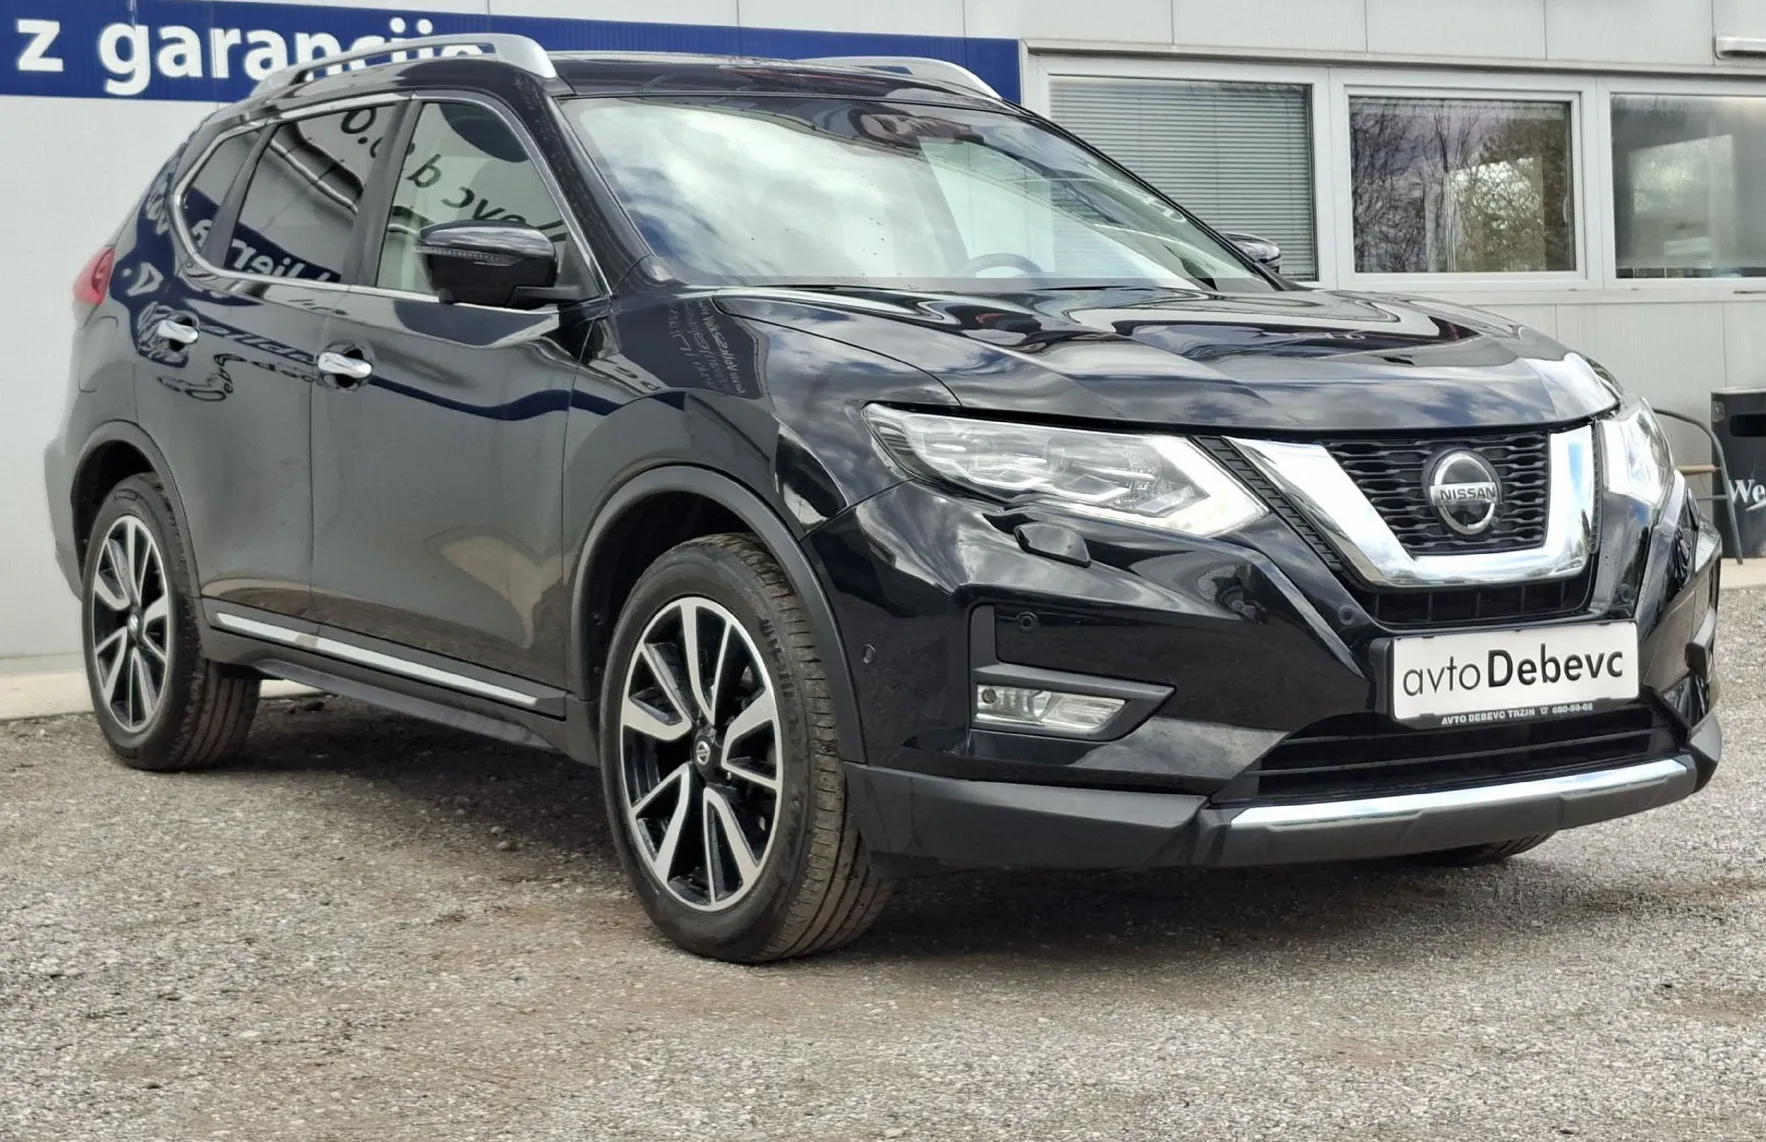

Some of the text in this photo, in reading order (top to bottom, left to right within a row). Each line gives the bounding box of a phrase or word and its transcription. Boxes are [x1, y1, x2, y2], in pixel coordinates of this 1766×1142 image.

[17, 17, 484, 96] z garanci
[1440, 487, 1495, 500] NISSAN
[1441, 715, 1467, 726] AVTO
